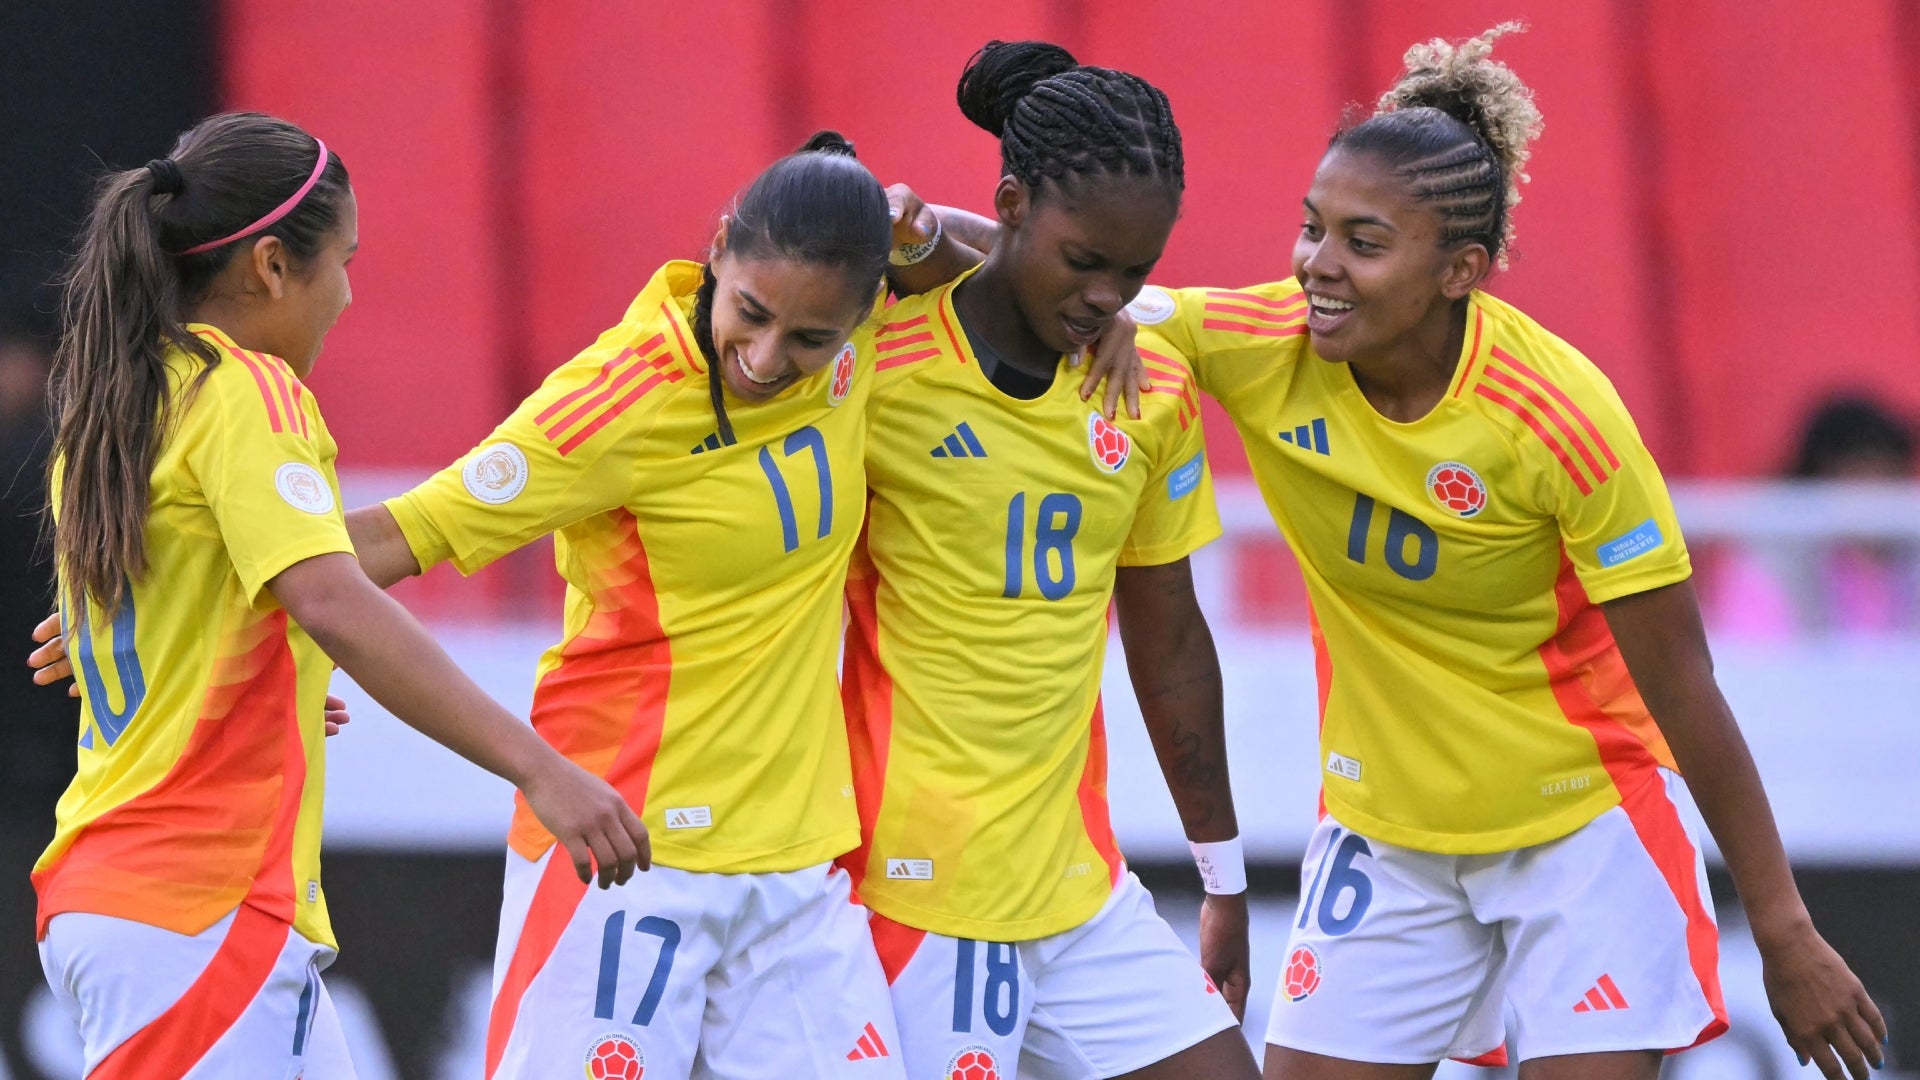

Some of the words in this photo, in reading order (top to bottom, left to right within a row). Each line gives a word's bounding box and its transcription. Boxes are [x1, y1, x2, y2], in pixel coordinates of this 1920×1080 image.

[759, 425, 833, 553] 17
[1347, 492, 1439, 581] 16
[1635, 532, 1646, 542] EL
[1001, 491, 1082, 600] 18
[1298, 828, 1373, 937] 16
[594, 910, 681, 1027] 17
[952, 937, 1019, 1036] 18
